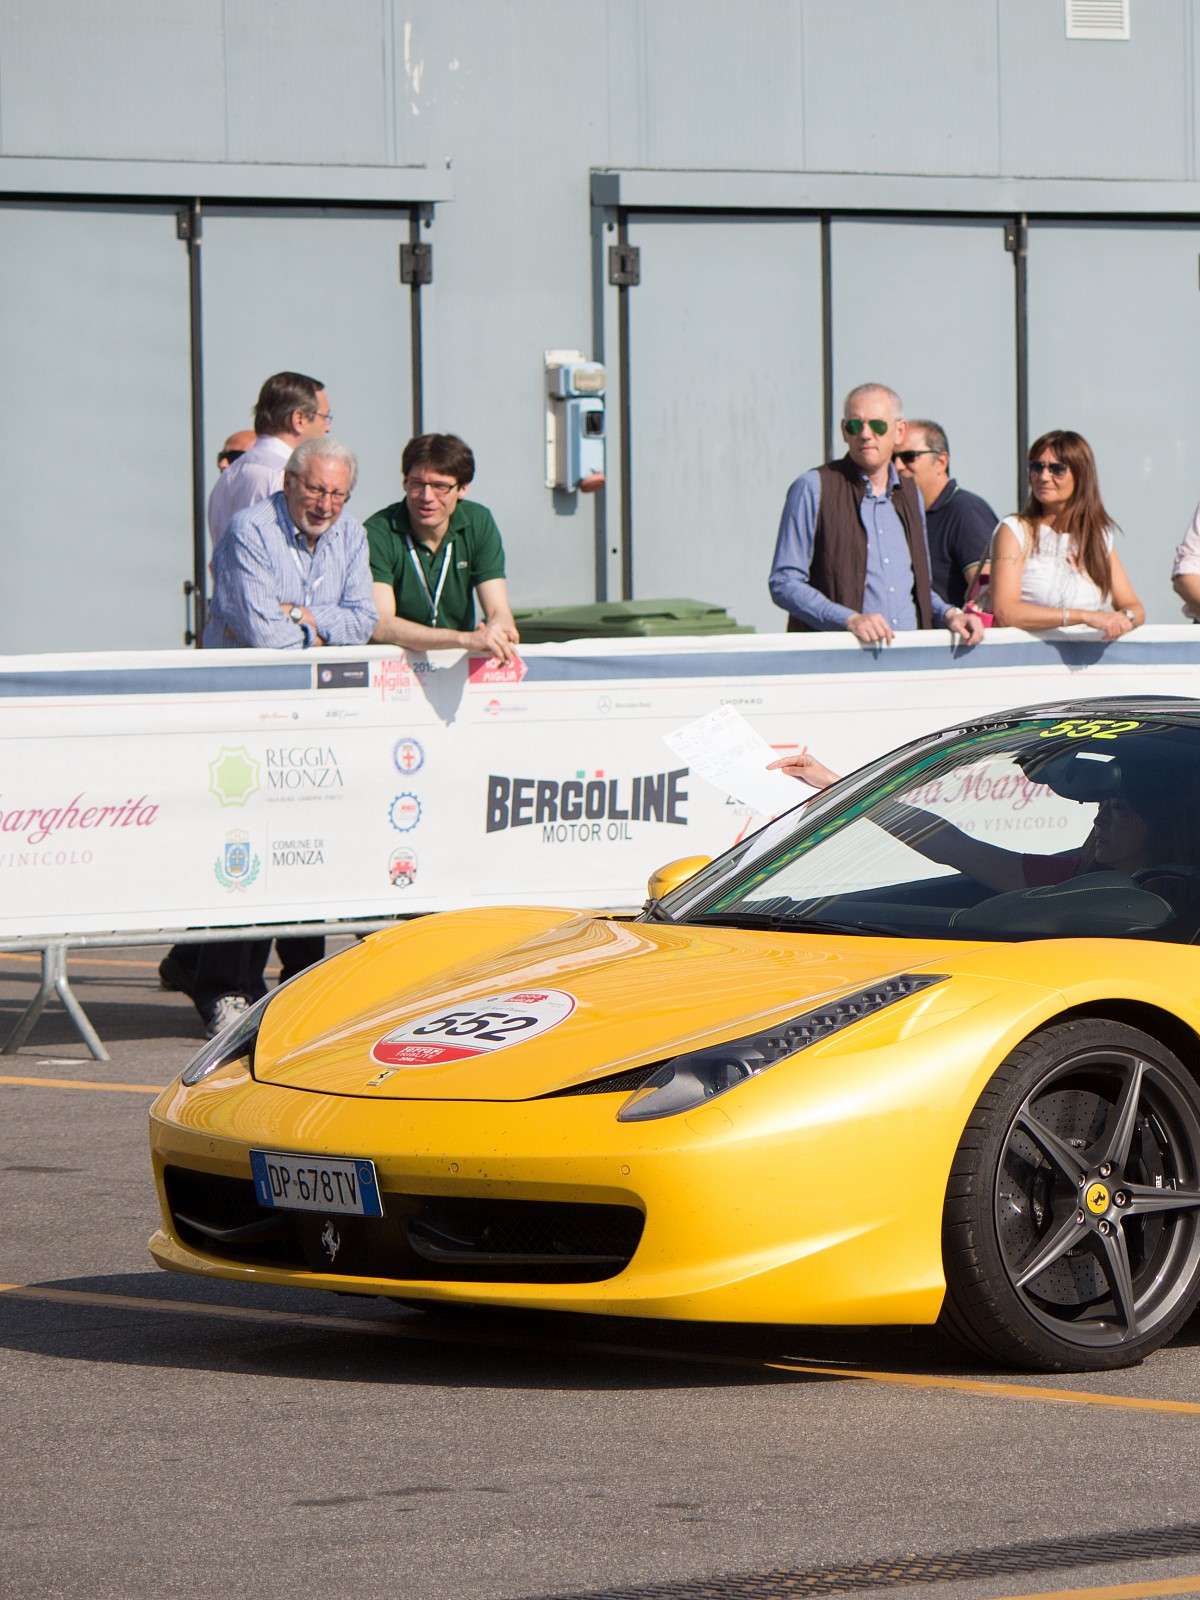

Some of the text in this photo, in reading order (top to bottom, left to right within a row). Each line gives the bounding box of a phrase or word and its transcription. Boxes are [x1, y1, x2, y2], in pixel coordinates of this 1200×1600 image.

[482, 671, 518, 682] MIGLIA
[1039, 720, 1140, 740] 552
[266, 746, 338, 768] REGGIA
[267, 768, 344, 790] MONZA
[486, 767, 690, 834] BERGOLINE
[0, 791, 160, 844] argherita
[543, 822, 633, 843] MOTOR OIL
[272, 838, 324, 851] COMUNE DI
[272, 850, 325, 867] MONZA
[412, 1012, 539, 1042] 552
